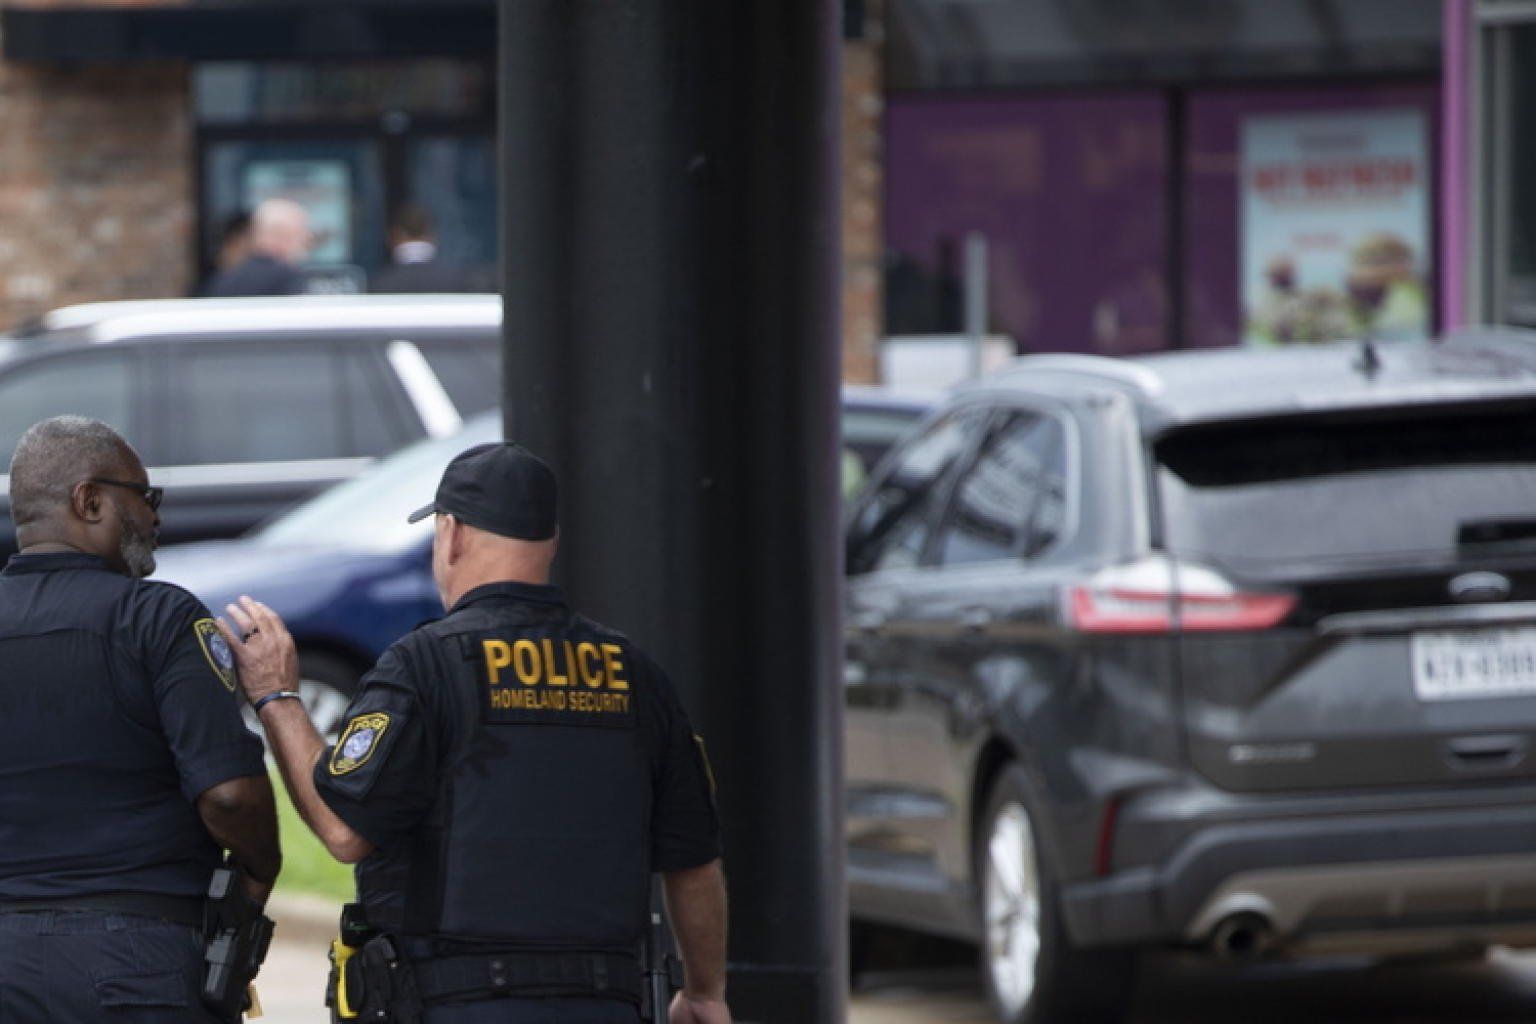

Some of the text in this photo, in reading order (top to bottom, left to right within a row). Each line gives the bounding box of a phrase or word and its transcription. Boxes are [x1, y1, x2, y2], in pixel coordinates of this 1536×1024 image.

[482, 638, 630, 690] POLICE
[490, 688, 630, 714] HOMELAND SECURITY
